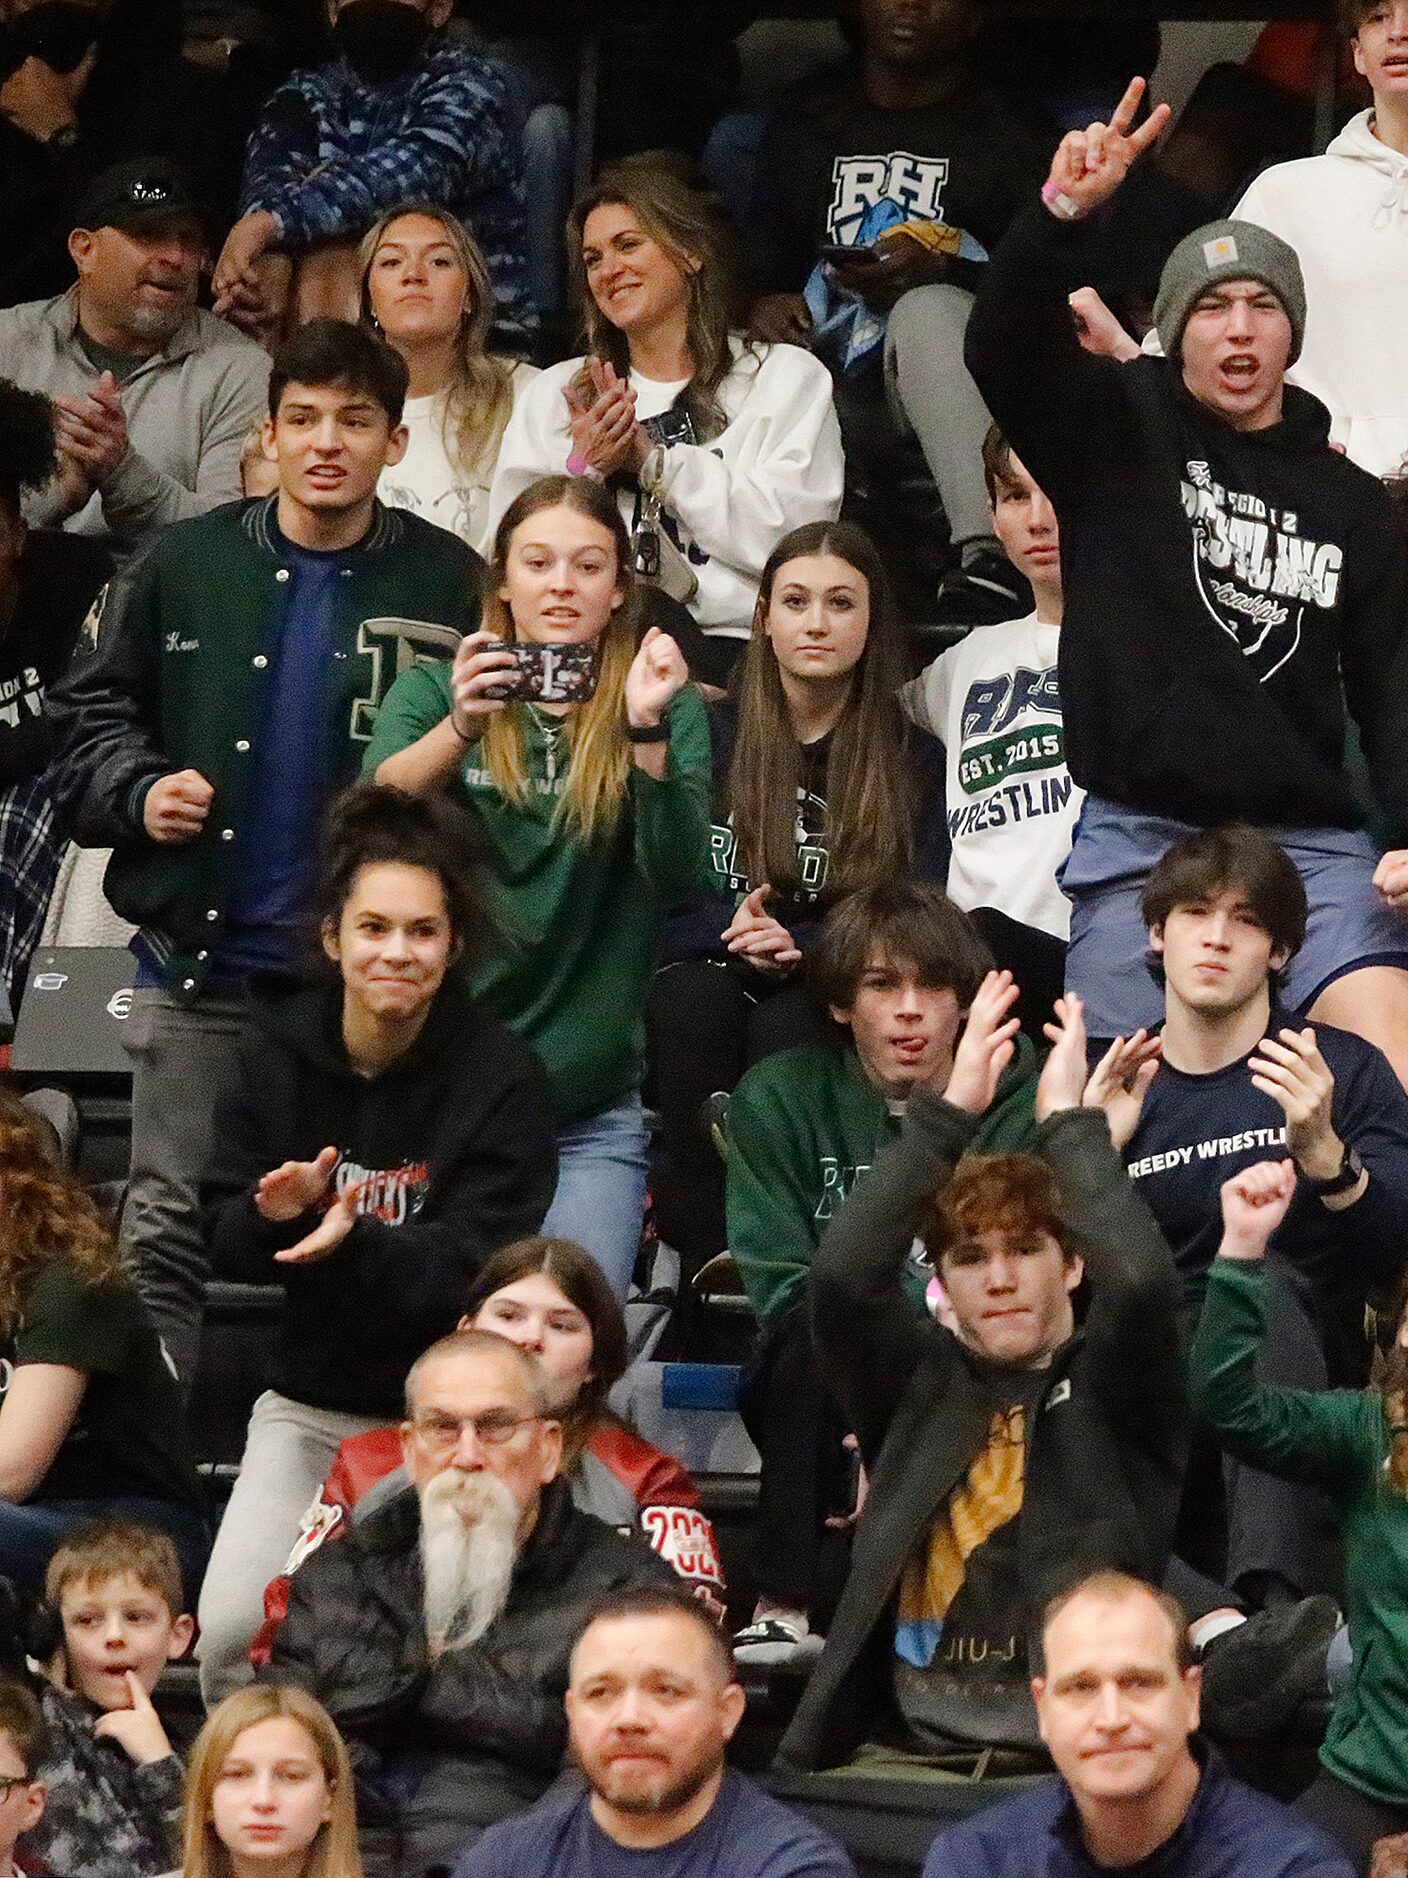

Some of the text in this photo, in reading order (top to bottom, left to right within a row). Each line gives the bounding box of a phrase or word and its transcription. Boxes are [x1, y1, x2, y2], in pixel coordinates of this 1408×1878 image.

[1281, 511, 1300, 534] 2
[22, 666, 41, 689] 2
[960, 734, 1061, 785] EST. 2015
[948, 775, 1074, 840] WRESTLIN
[1127, 1127, 1287, 1179] REEDY WRESTLI
[947, 1635, 1017, 1662] JIU-J
